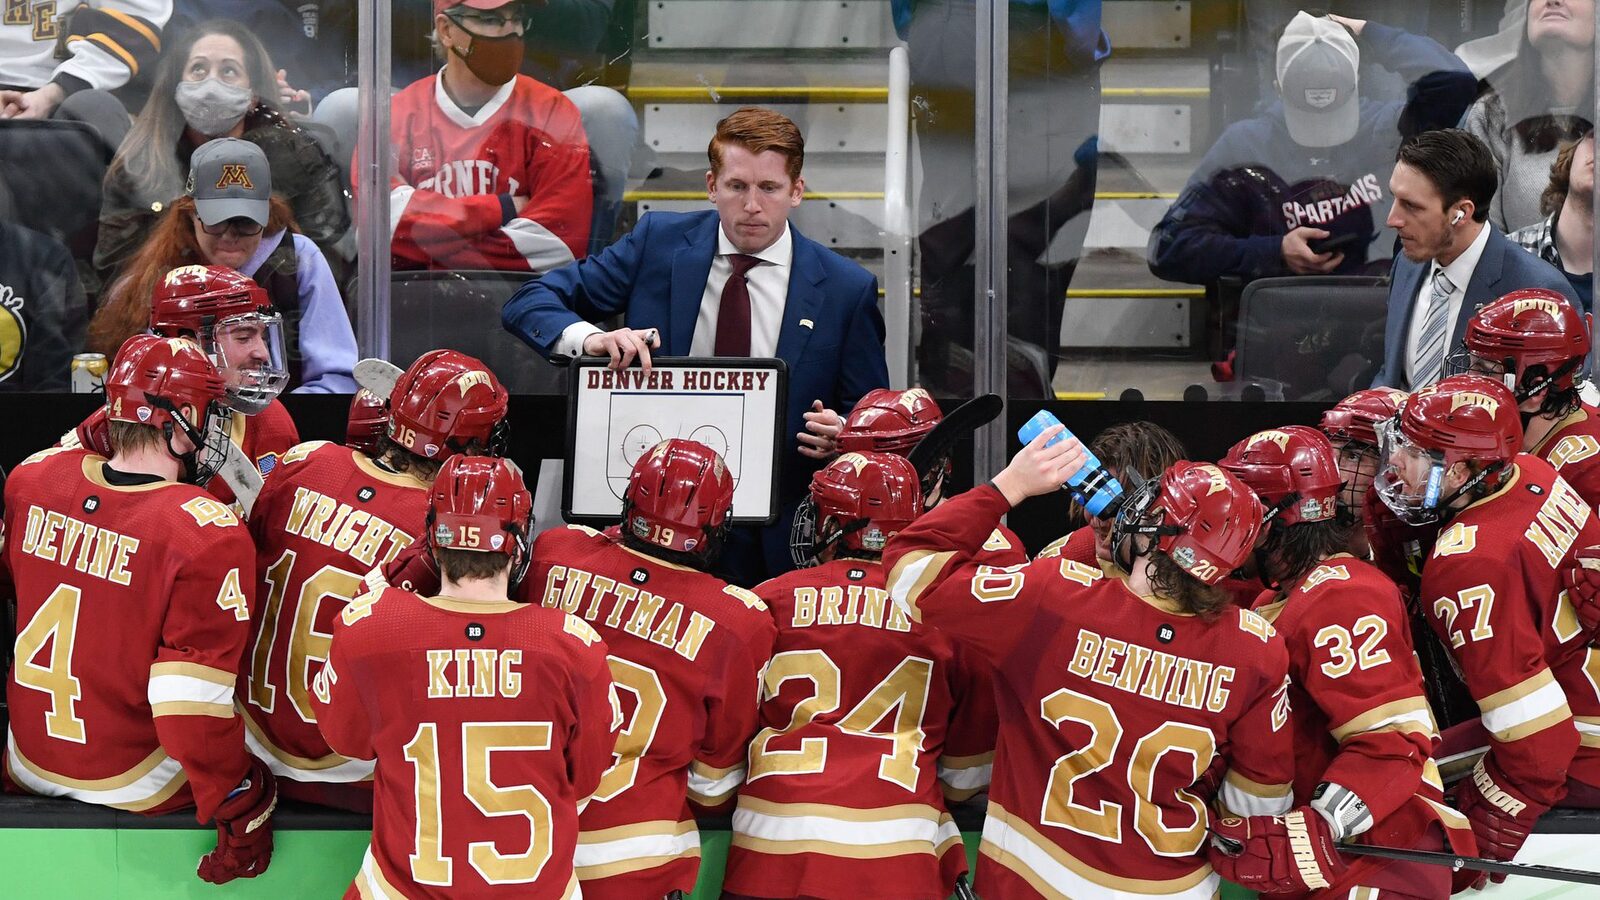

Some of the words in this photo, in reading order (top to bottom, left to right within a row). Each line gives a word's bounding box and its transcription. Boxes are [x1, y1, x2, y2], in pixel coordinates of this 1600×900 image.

[215, 163, 254, 189] M
[1282, 174, 1382, 230] SPARTANS
[1513, 298, 1562, 322] DENVER
[113, 397, 122, 416] 4
[587, 370, 674, 390] DENVER
[683, 371, 770, 391] HOCKEY
[397, 424, 416, 449] 16
[22, 504, 140, 586] DEVINE
[285, 486, 416, 567] WRIGHT
[459, 526, 480, 547] 15
[651, 524, 675, 547] 19
[216, 567, 250, 622] 4
[1190, 559, 1219, 582] 20
[249, 548, 366, 724] 16
[469, 627, 481, 636] RB
[541, 564, 716, 662] GUTTMAN
[1434, 583, 1495, 650] 27
[14, 582, 87, 744] 4
[426, 649, 523, 698] KING
[1067, 628, 1236, 713] BENNING
[1314, 614, 1391, 680] 32
[747, 649, 934, 793] 24
[1041, 688, 1217, 858] 20
[403, 722, 553, 886] 15
